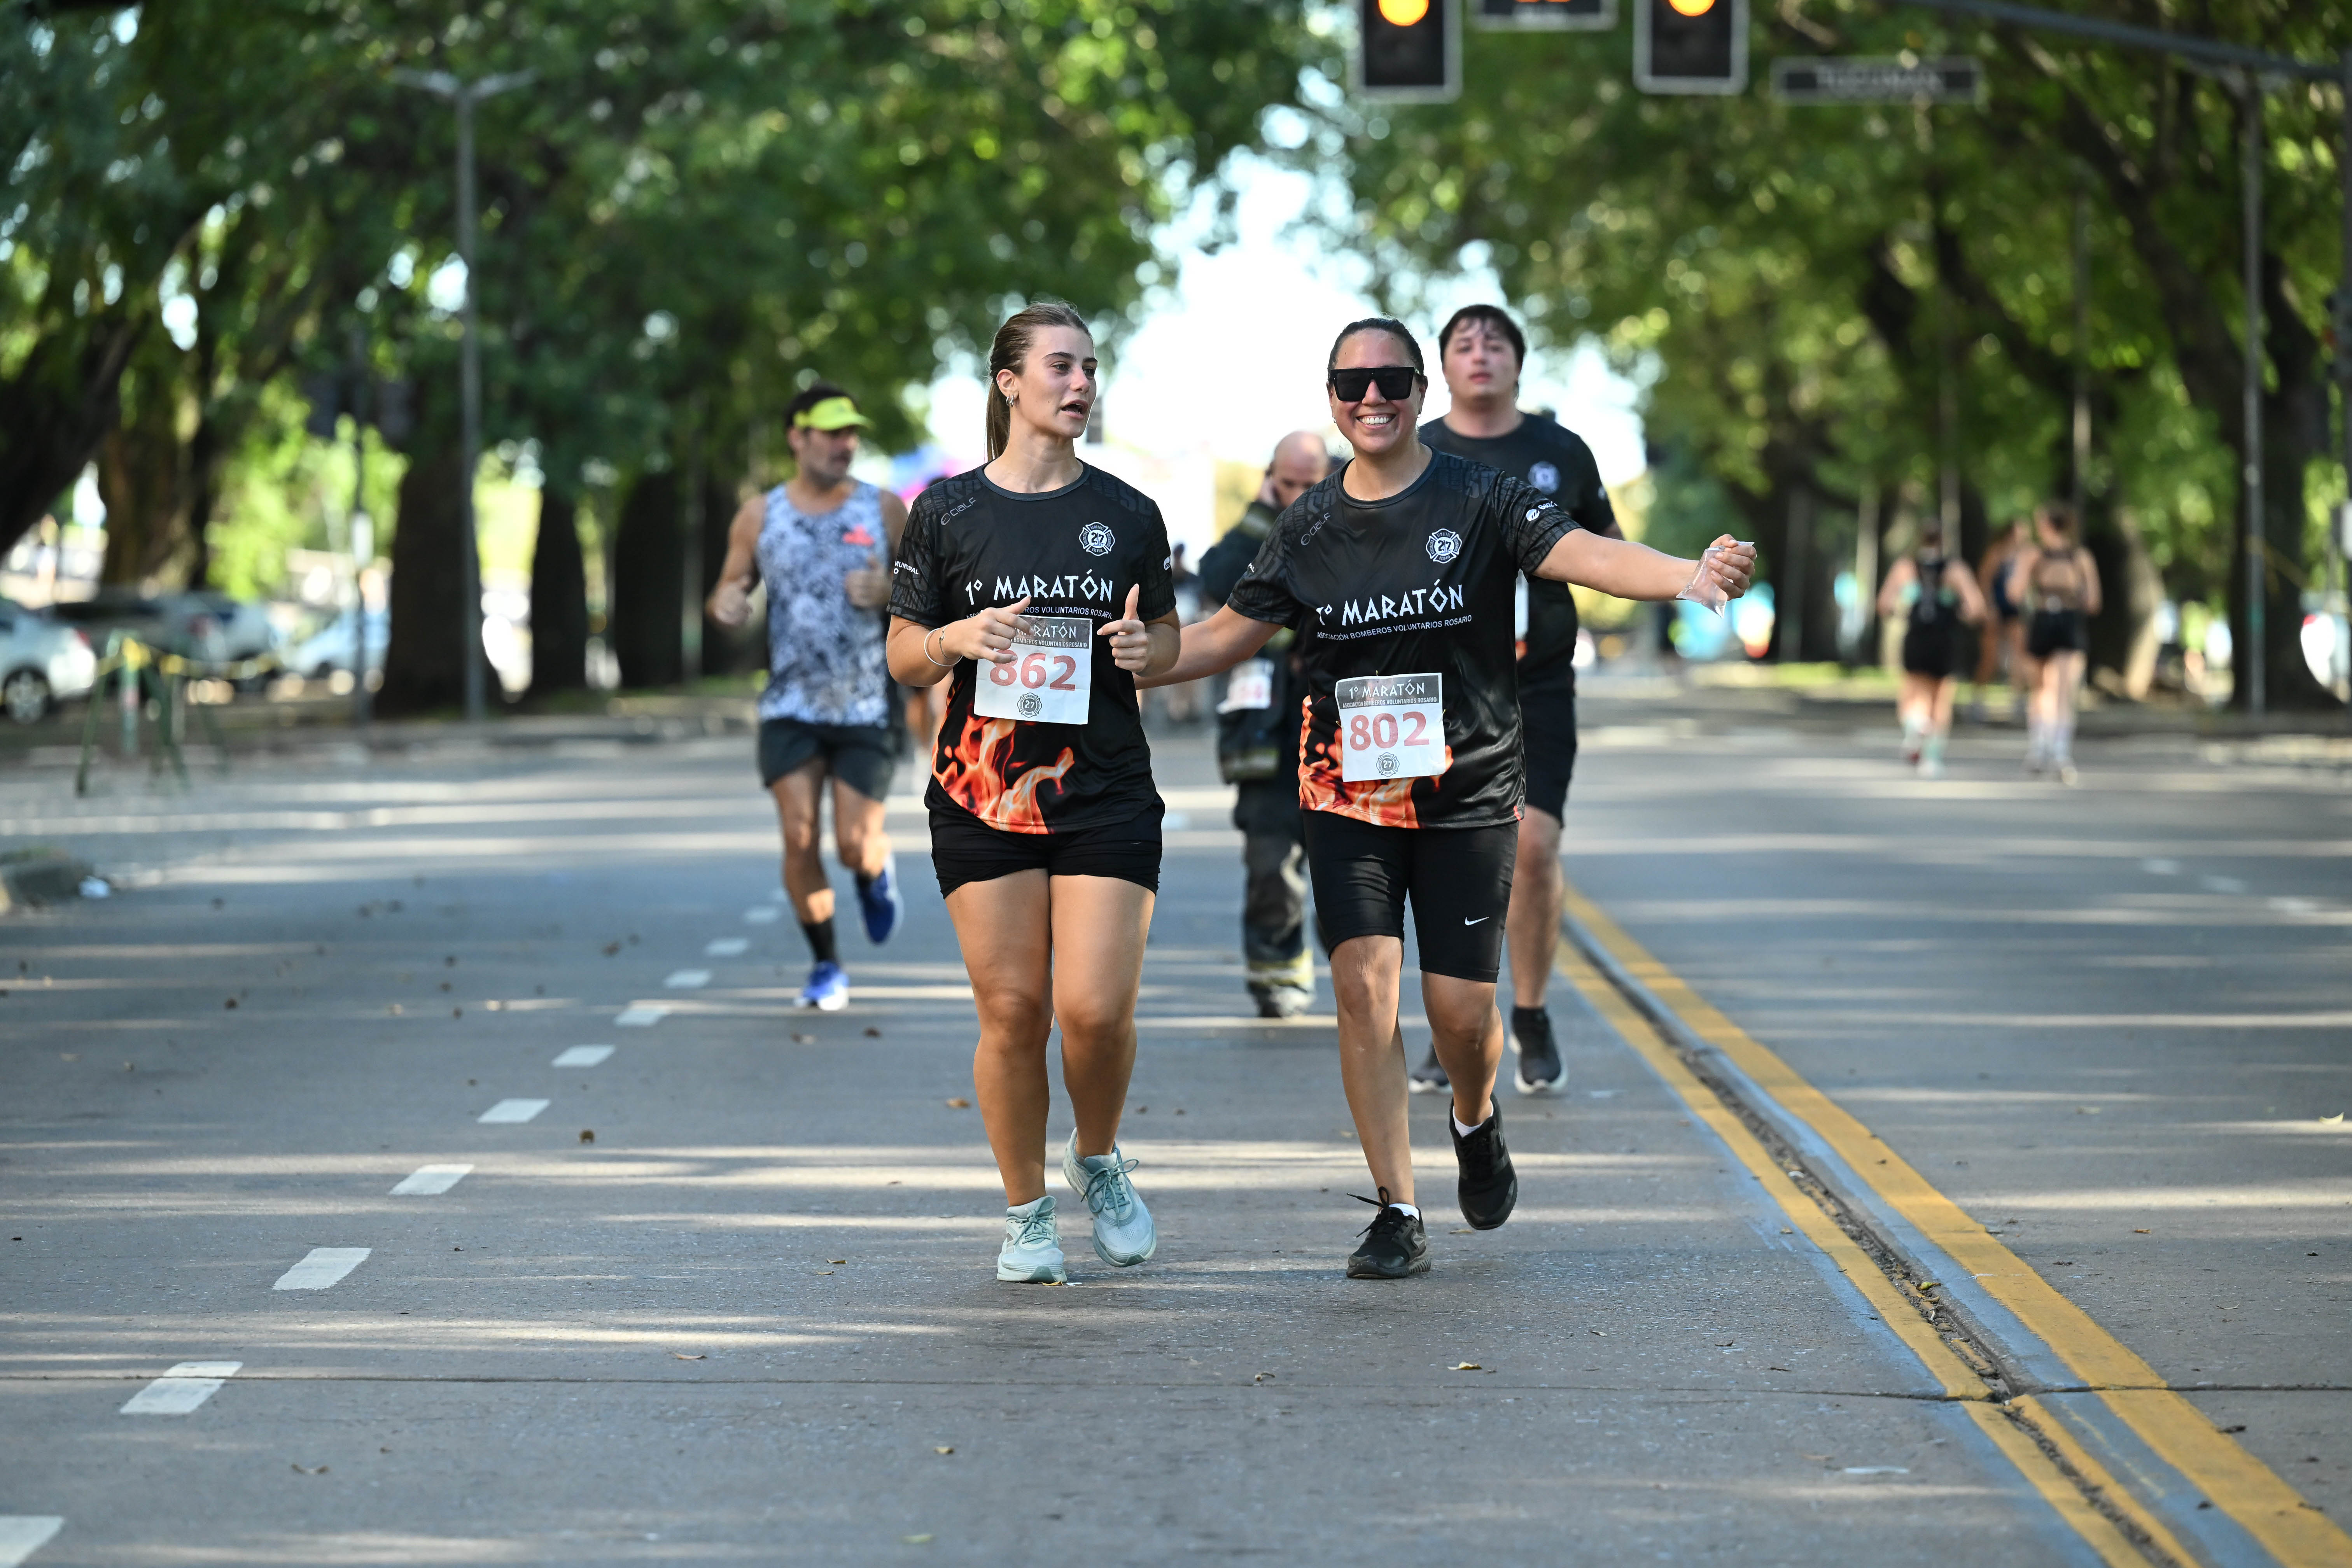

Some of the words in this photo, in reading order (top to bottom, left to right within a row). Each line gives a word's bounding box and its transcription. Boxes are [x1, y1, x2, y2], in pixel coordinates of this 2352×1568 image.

[1091, 532, 1104, 543] 27
[1438, 540, 1451, 551] 27
[993, 569, 1113, 603] MARATÓN
[1041, 606, 1089, 615] VOLUNTARIOS
[1342, 579, 1463, 626] MARATÓN
[1317, 631, 1349, 640] ASOCIACIÓN
[1351, 626, 1392, 639] BOMBEROS
[1393, 620, 1442, 632] VOLUNTARIOS
[1444, 614, 1472, 627] ROSARIO
[990, 649, 1076, 691] 862
[1362, 679, 1425, 698] MARATÓN
[1025, 700, 1035, 709] 27
[1350, 711, 1430, 751] 802
[1383, 760, 1392, 768] 27
